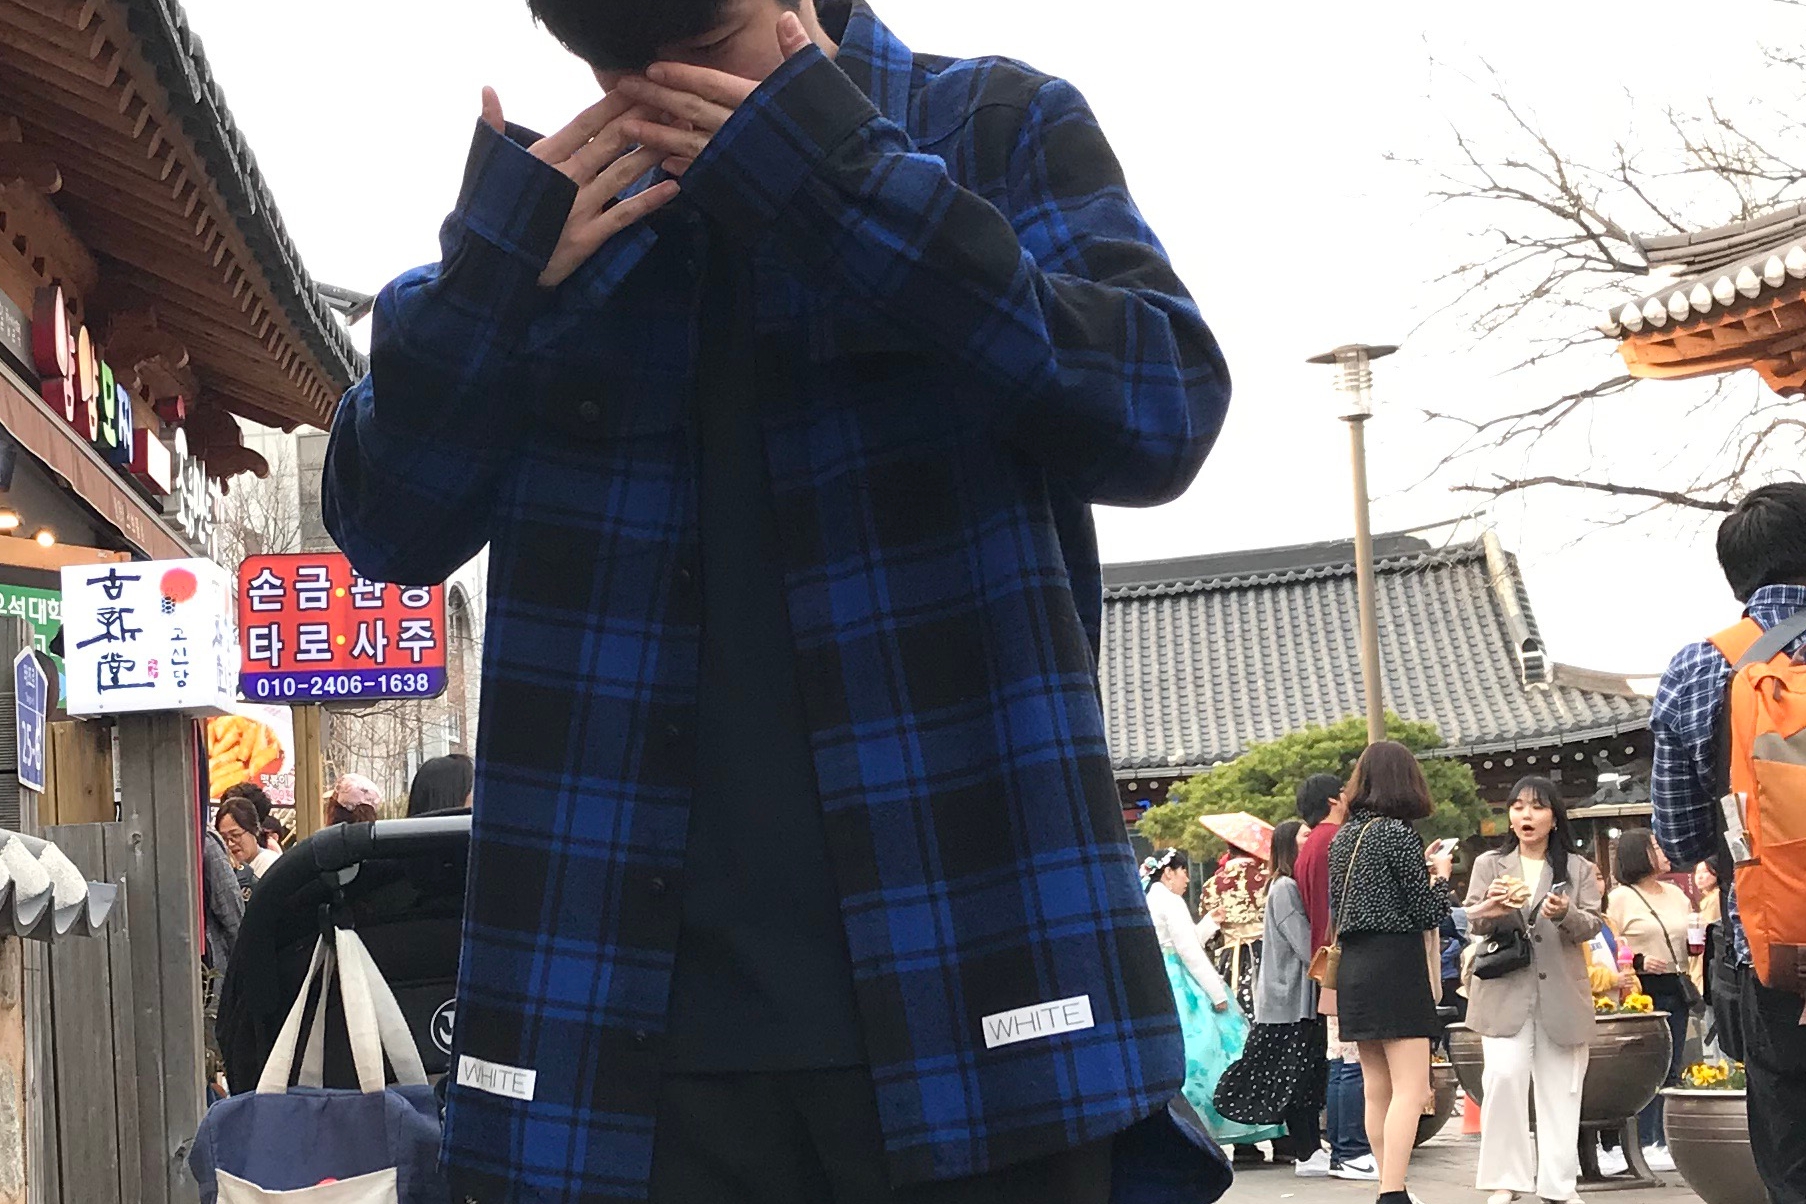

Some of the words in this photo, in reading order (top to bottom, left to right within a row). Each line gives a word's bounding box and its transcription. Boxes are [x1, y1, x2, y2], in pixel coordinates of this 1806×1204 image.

[248, 567, 331, 611] 손금
[170, 627, 189, 688] 고신당
[248, 622, 332, 668] 타로
[351, 619, 436, 664] 사주
[257, 673, 429, 697] 010-2406-1638
[988, 1002, 1084, 1040] WHITE
[463, 1060, 527, 1095] WHITE
